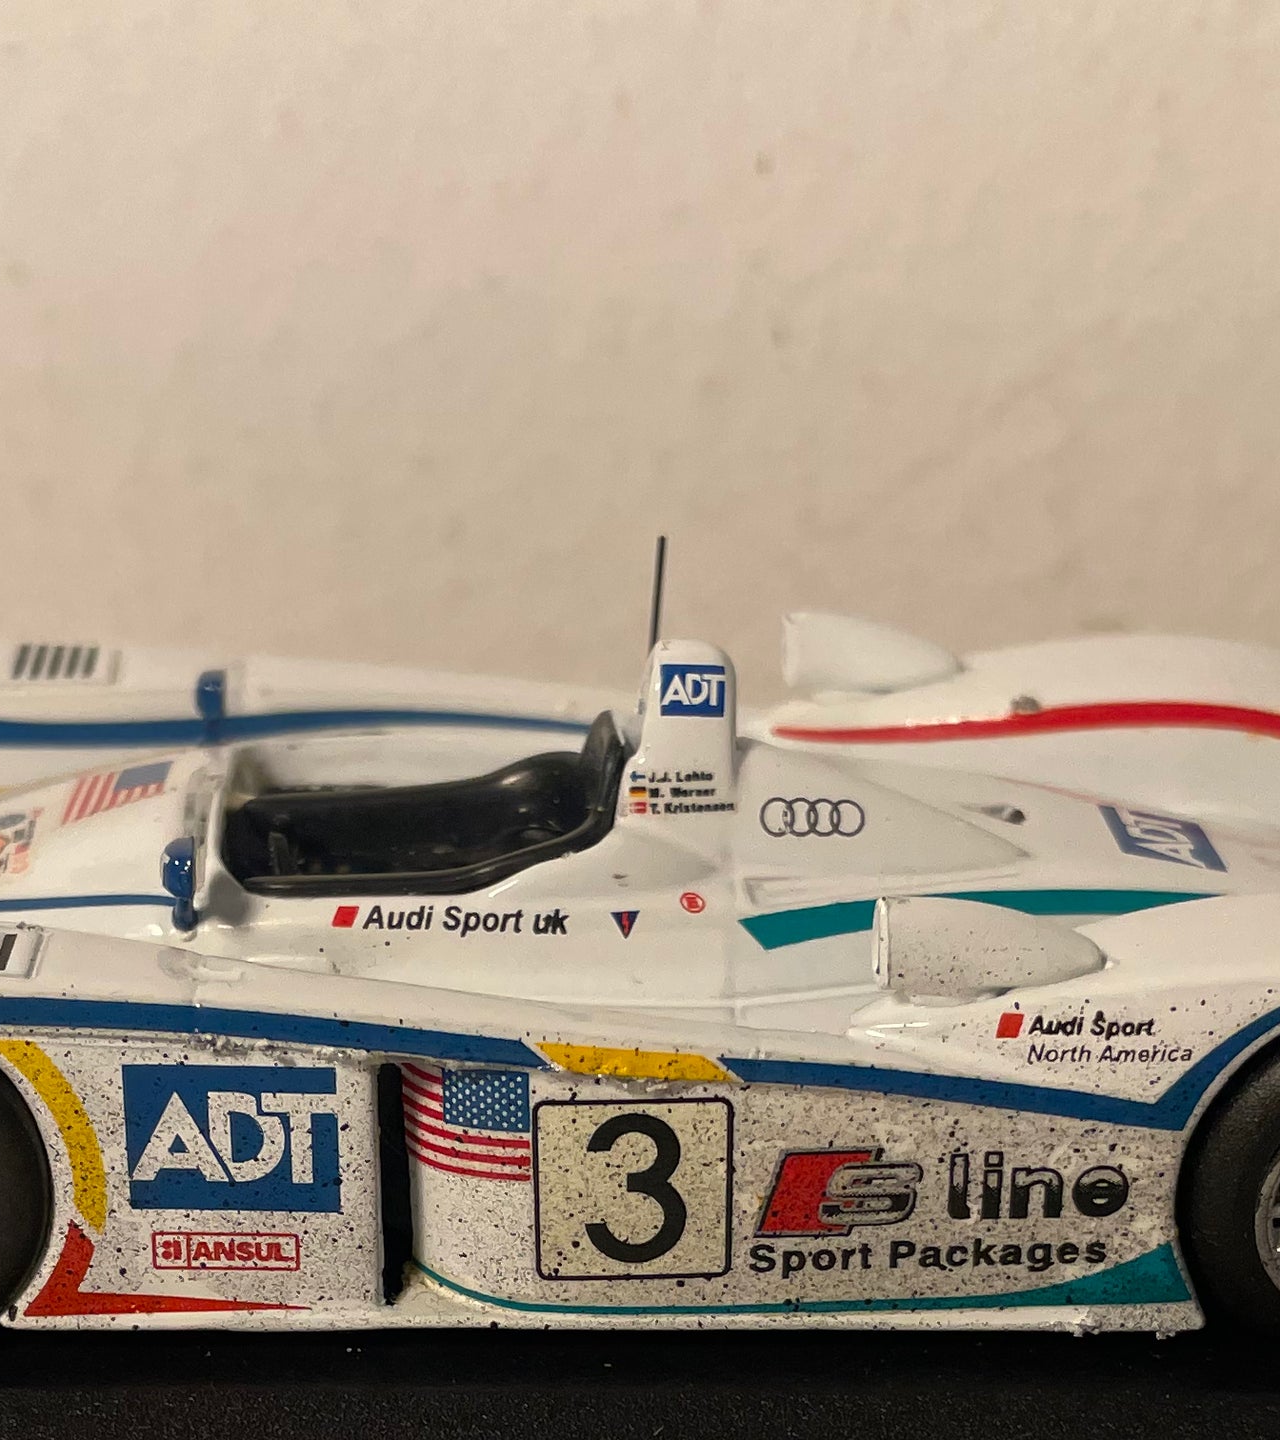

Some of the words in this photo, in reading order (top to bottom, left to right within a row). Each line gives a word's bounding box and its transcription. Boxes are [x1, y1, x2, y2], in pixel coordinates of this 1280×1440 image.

[661, 673, 726, 706] ADT
[363, 905, 433, 930] Audi
[442, 906, 524, 937] Sport
[533, 909, 569, 935] uk
[1028, 1015, 1084, 1036] Audi
[1090, 1013, 1155, 1041] Sport
[1027, 1044, 1091, 1064] North
[1098, 1045, 1193, 1063] America
[129, 1090, 336, 1184] ADT
[585, 1113, 687, 1263] 3
[947, 1150, 1130, 1219] line
[193, 1241, 295, 1263] ANSUL
[749, 1242, 872, 1279] Sport
[889, 1238, 1108, 1273] Packages
